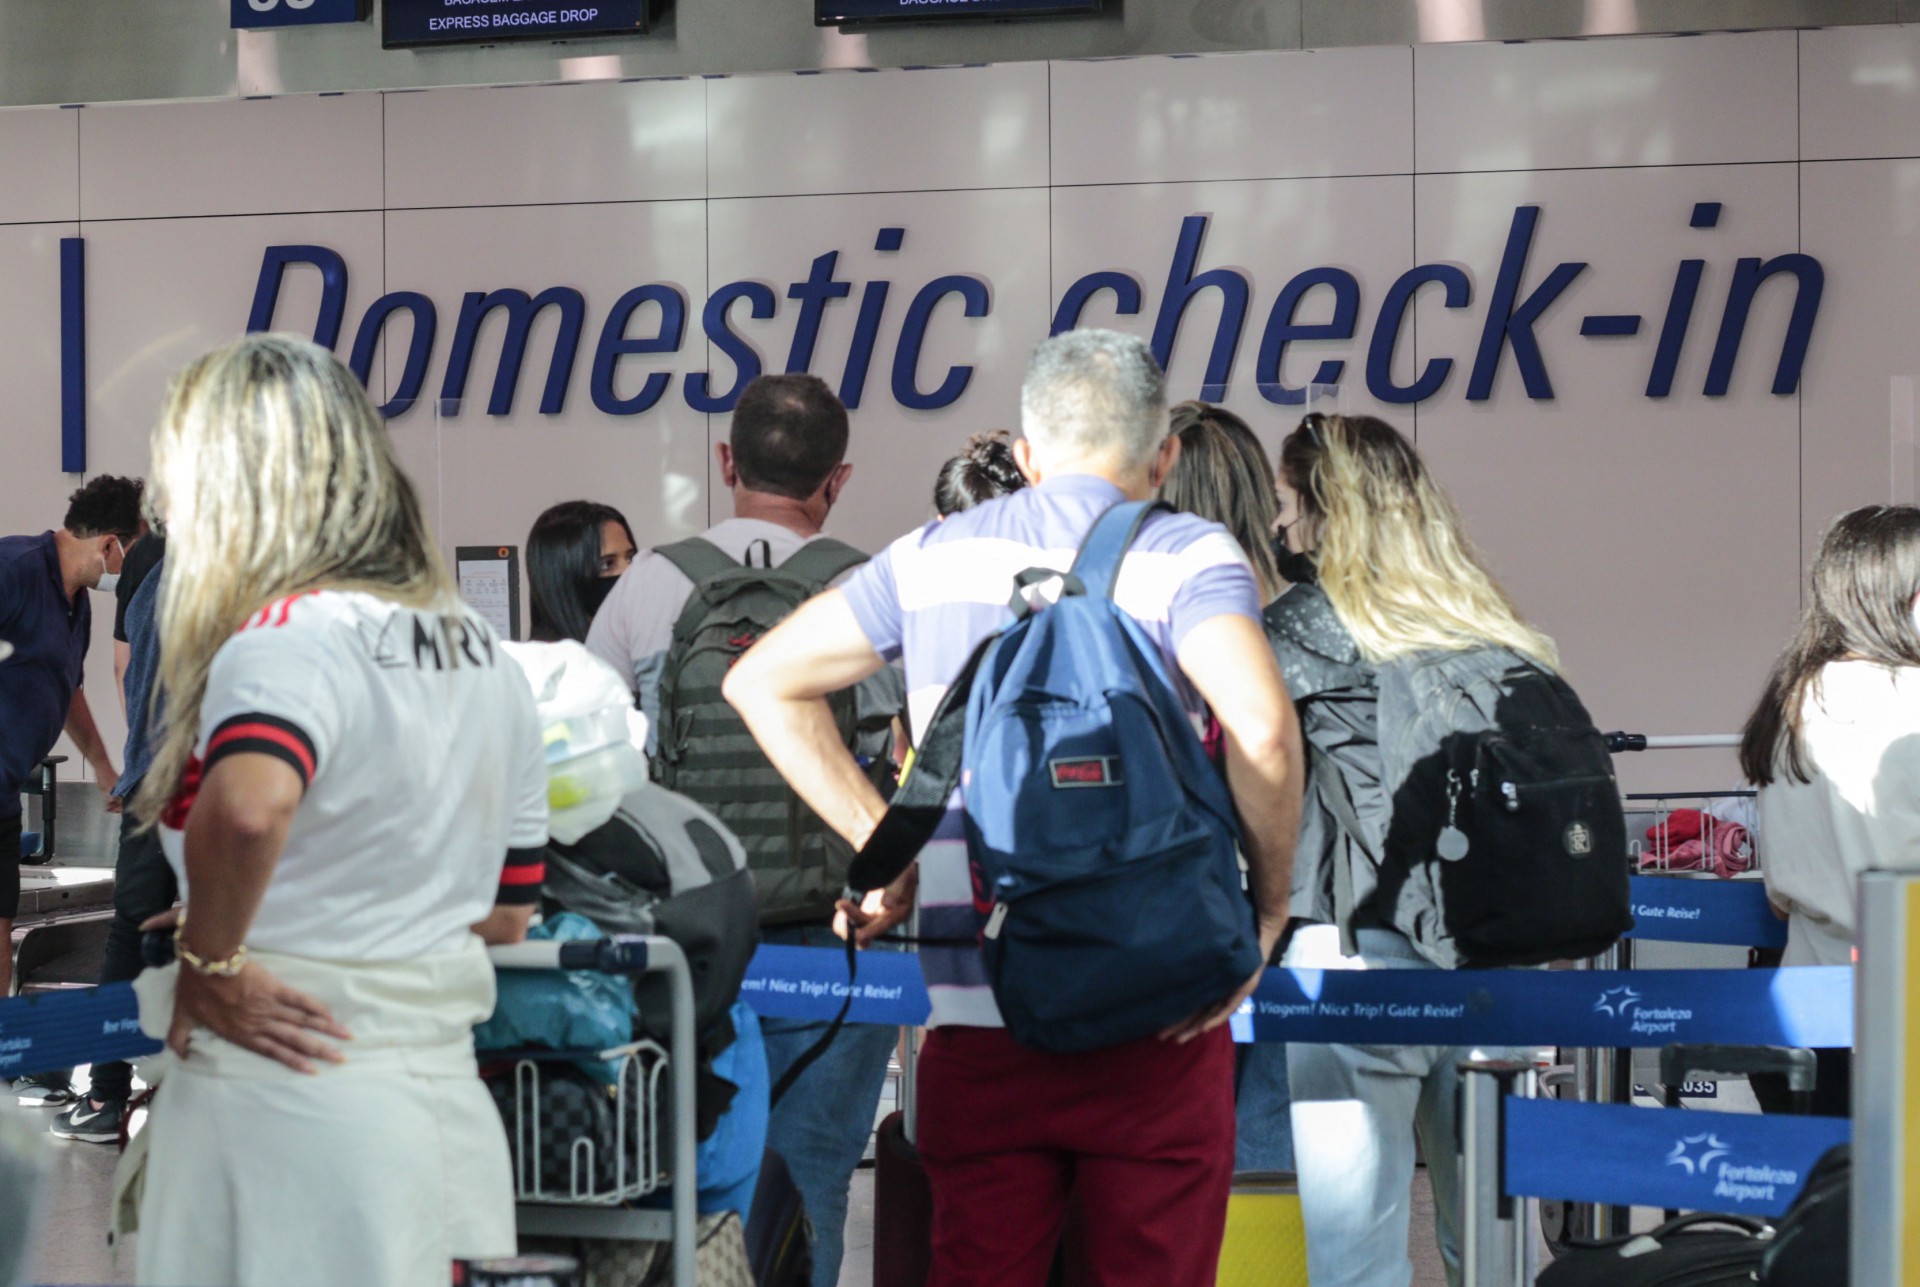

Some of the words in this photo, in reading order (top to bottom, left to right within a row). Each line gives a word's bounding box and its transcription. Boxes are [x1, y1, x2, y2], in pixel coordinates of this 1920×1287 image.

[429, 14, 490, 31] EXPRESS
[492, 11, 558, 27] BAGGAGE
[560, 8, 599, 23] DROP
[247, 228, 990, 417] Domestic
[1637, 904, 1666, 918] Gute
[1666, 906, 1701, 920] Reise!
[768, 979, 798, 993] Nice
[800, 980, 829, 998] Trip!
[863, 984, 903, 1000] Reise!
[1259, 1000, 1316, 1019] Viagem!
[1319, 1002, 1350, 1016] Nice
[1353, 1002, 1384, 1020] Trip!
[1387, 1003, 1421, 1018] Gute
[1423, 1003, 1465, 1018] Reise!
[1633, 1006, 1692, 1020] Fortaleza
[1630, 1020, 1677, 1036] Airport
[1717, 1161, 1798, 1186] Fortaleza
[1713, 1179, 1776, 1203] Airport
